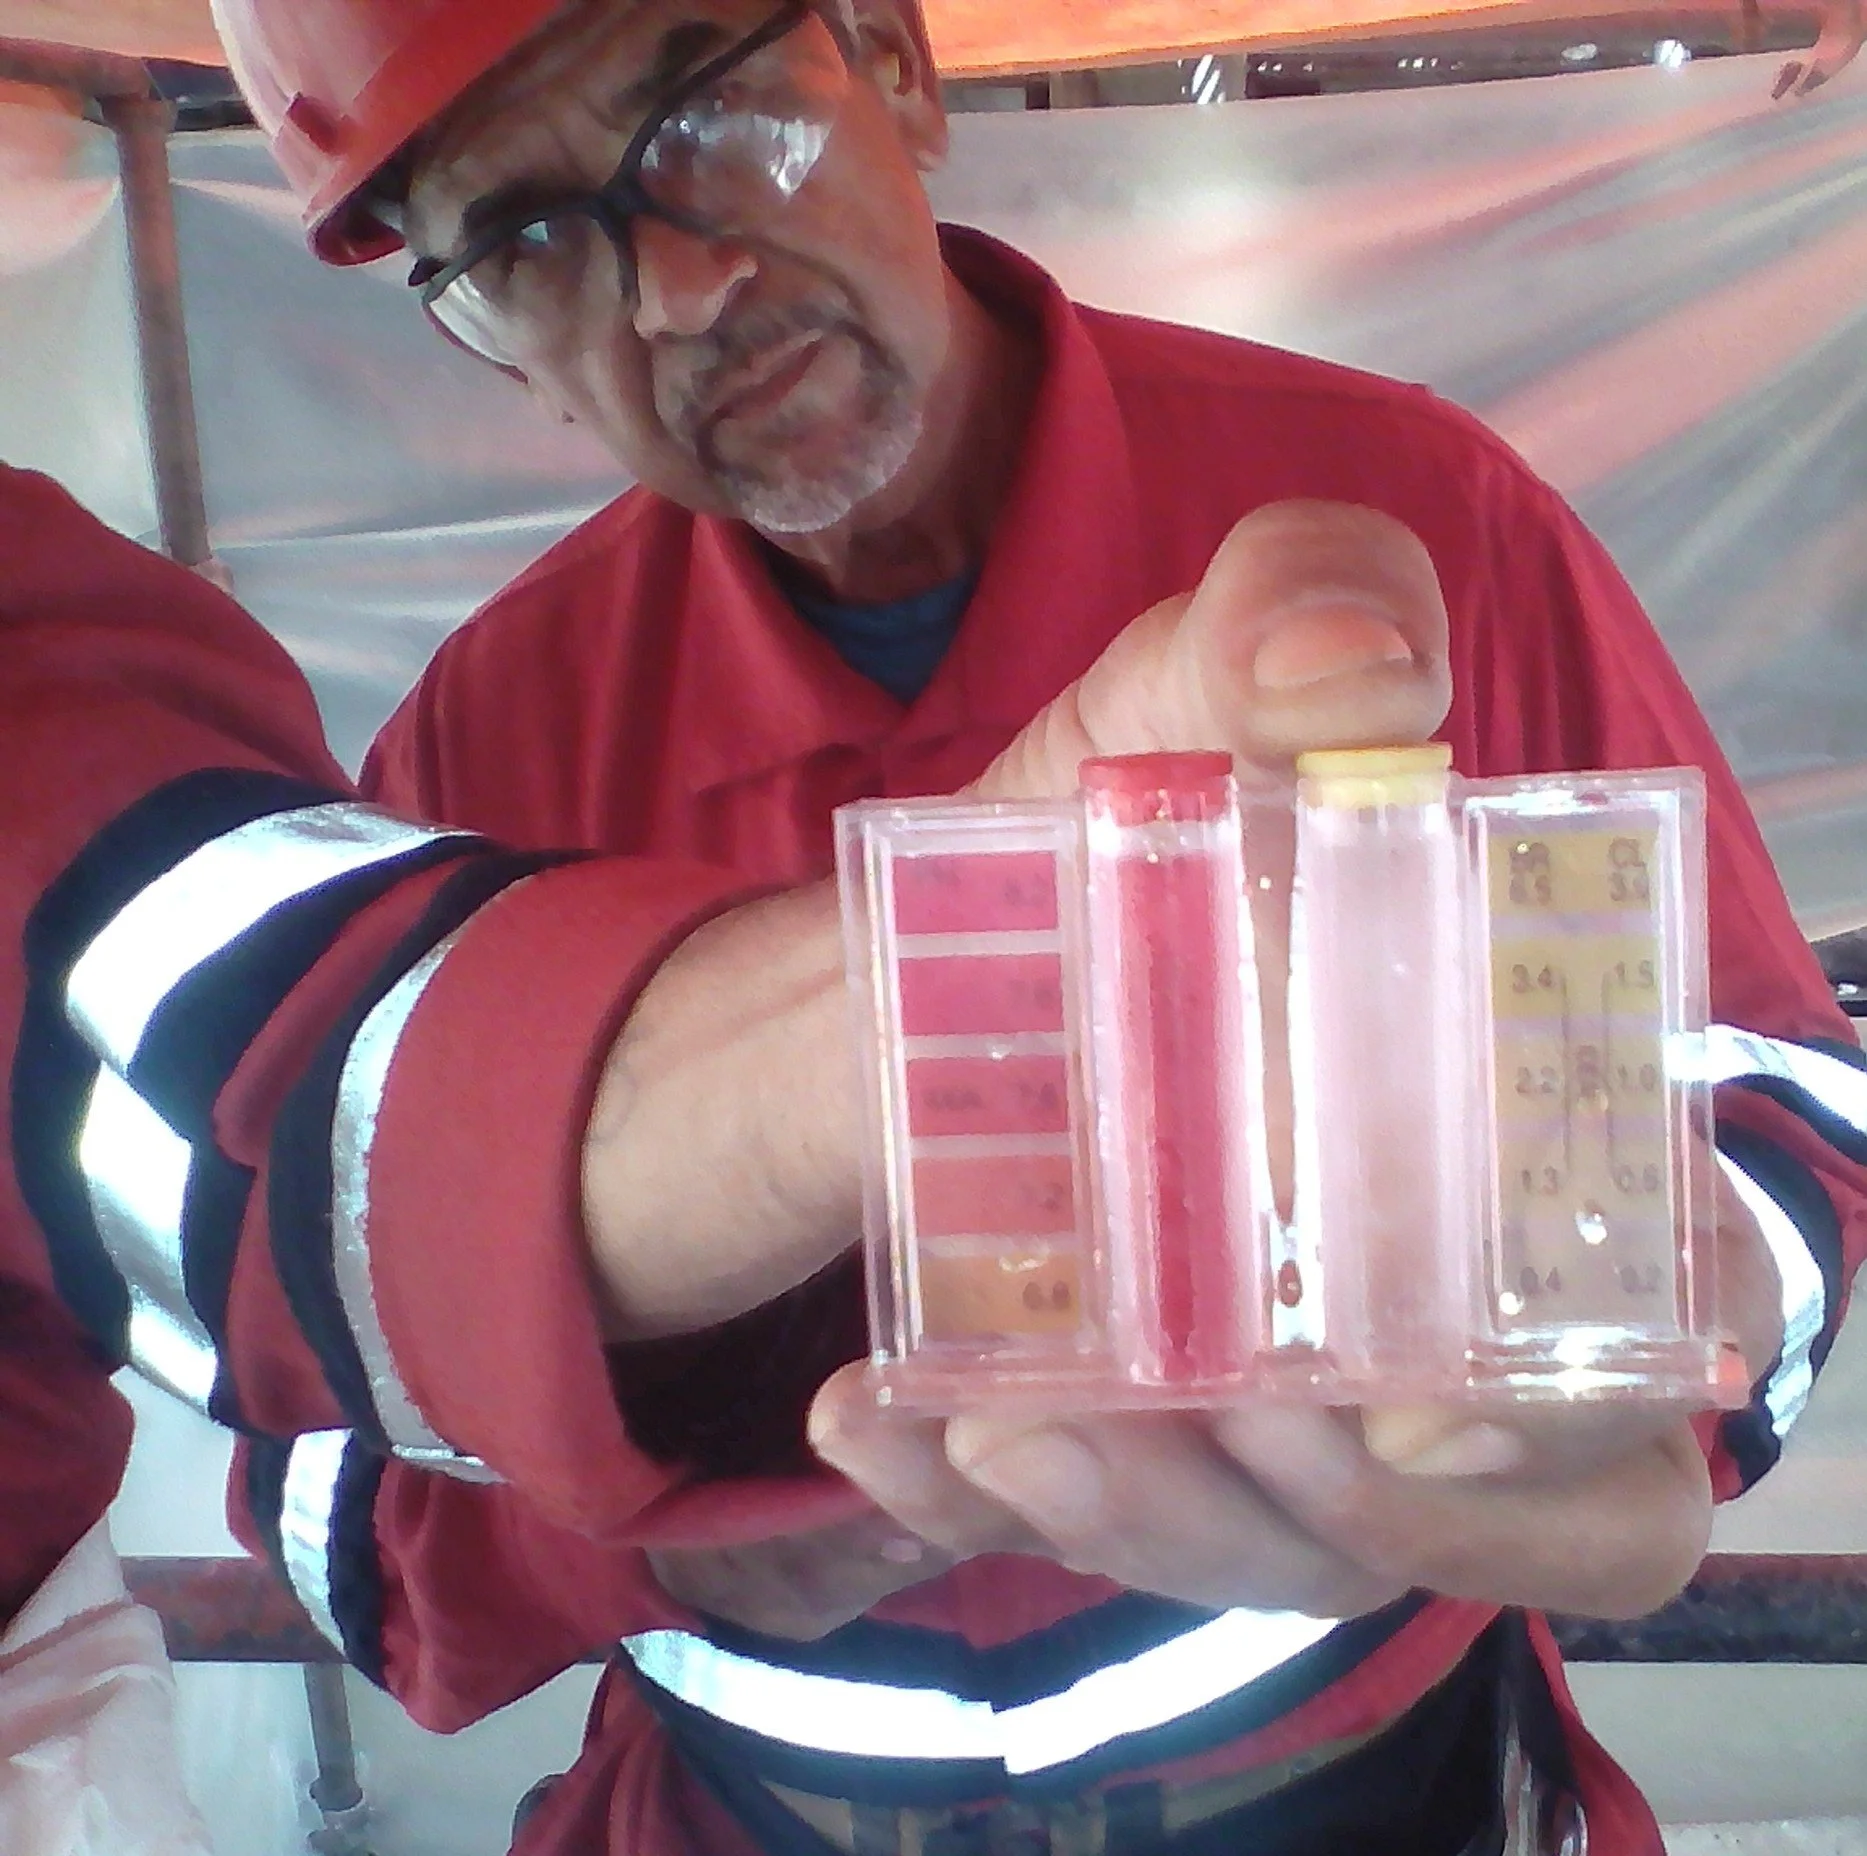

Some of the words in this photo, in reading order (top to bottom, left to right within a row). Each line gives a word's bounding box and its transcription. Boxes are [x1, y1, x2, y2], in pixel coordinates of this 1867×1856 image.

[1608, 837, 1646, 868] CL
[1512, 963, 1553, 994] 3.4
[1614, 959, 1655, 989] 1.5
[1520, 1165, 1560, 1196] 1.3
